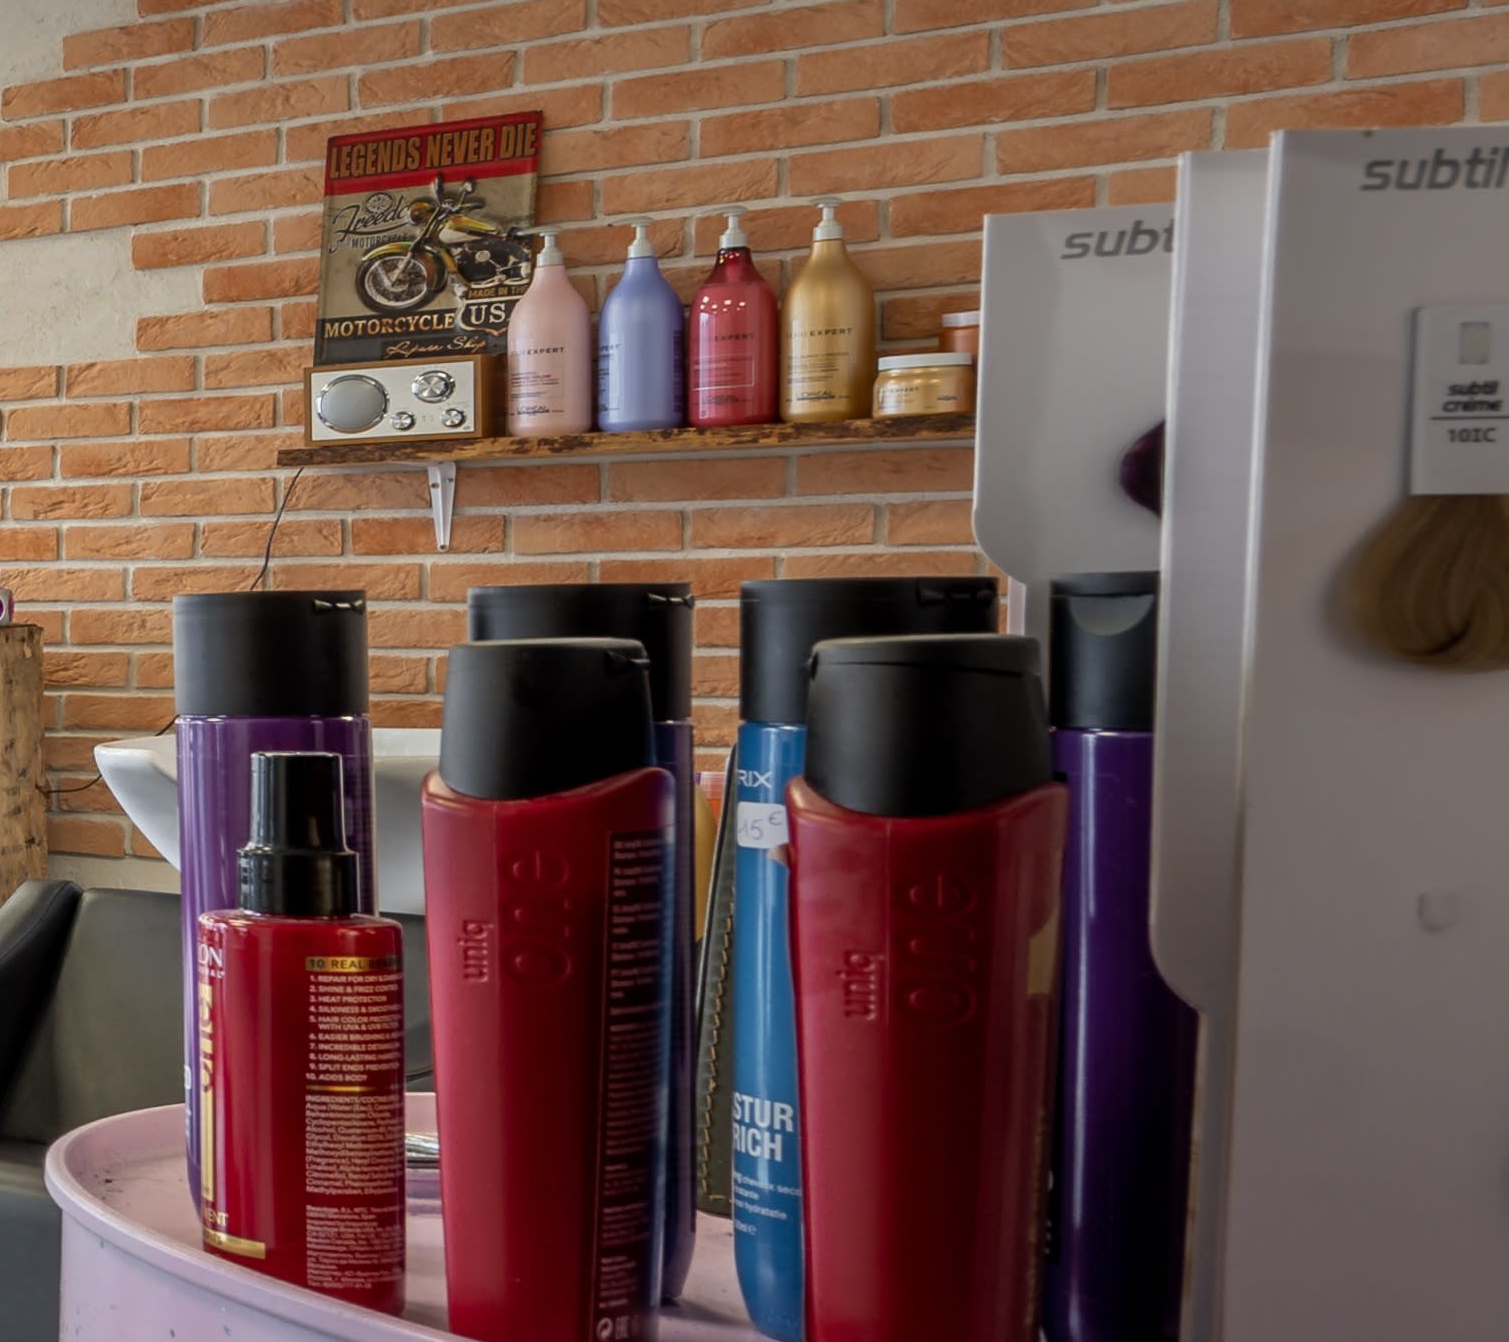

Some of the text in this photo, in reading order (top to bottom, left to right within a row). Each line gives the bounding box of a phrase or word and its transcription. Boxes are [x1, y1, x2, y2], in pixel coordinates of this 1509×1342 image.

[329, 122, 538, 179] LEGENDS NEVER DIE
[1061, 220, 1176, 259] subt
[468, 287, 495, 299] MADE
[498, 286, 509, 297] IN
[469, 302, 510, 326] US
[324, 313, 455, 338] MOTORCYCLE
[810, 328, 853, 337] EXPERT
[527, 347, 565, 355] EXPERT
[1447, 380, 1500, 397] subtil
[737, 769, 773, 788] RIX
[457, 920, 494, 983] uniq
[309, 959, 366, 969] 10 REAL
[318, 975, 347, 983] REPAIR
[318, 985, 344, 993] SHINE
[835, 950, 885, 1021] uniq
[318, 995, 341, 1003] HEAT
[318, 1015, 339, 1023] HAIR
[318, 1033, 348, 1041] EASIER
[318, 1043, 366, 1051] INCREDIBLE
[318, 1063, 341, 1071] SPLIT
[342, 1063, 364, 1071] ENDS
[318, 1073, 343, 1081] ADDS
[345, 1074, 368, 1082] BODY
[733, 1091, 794, 1133] STUR
